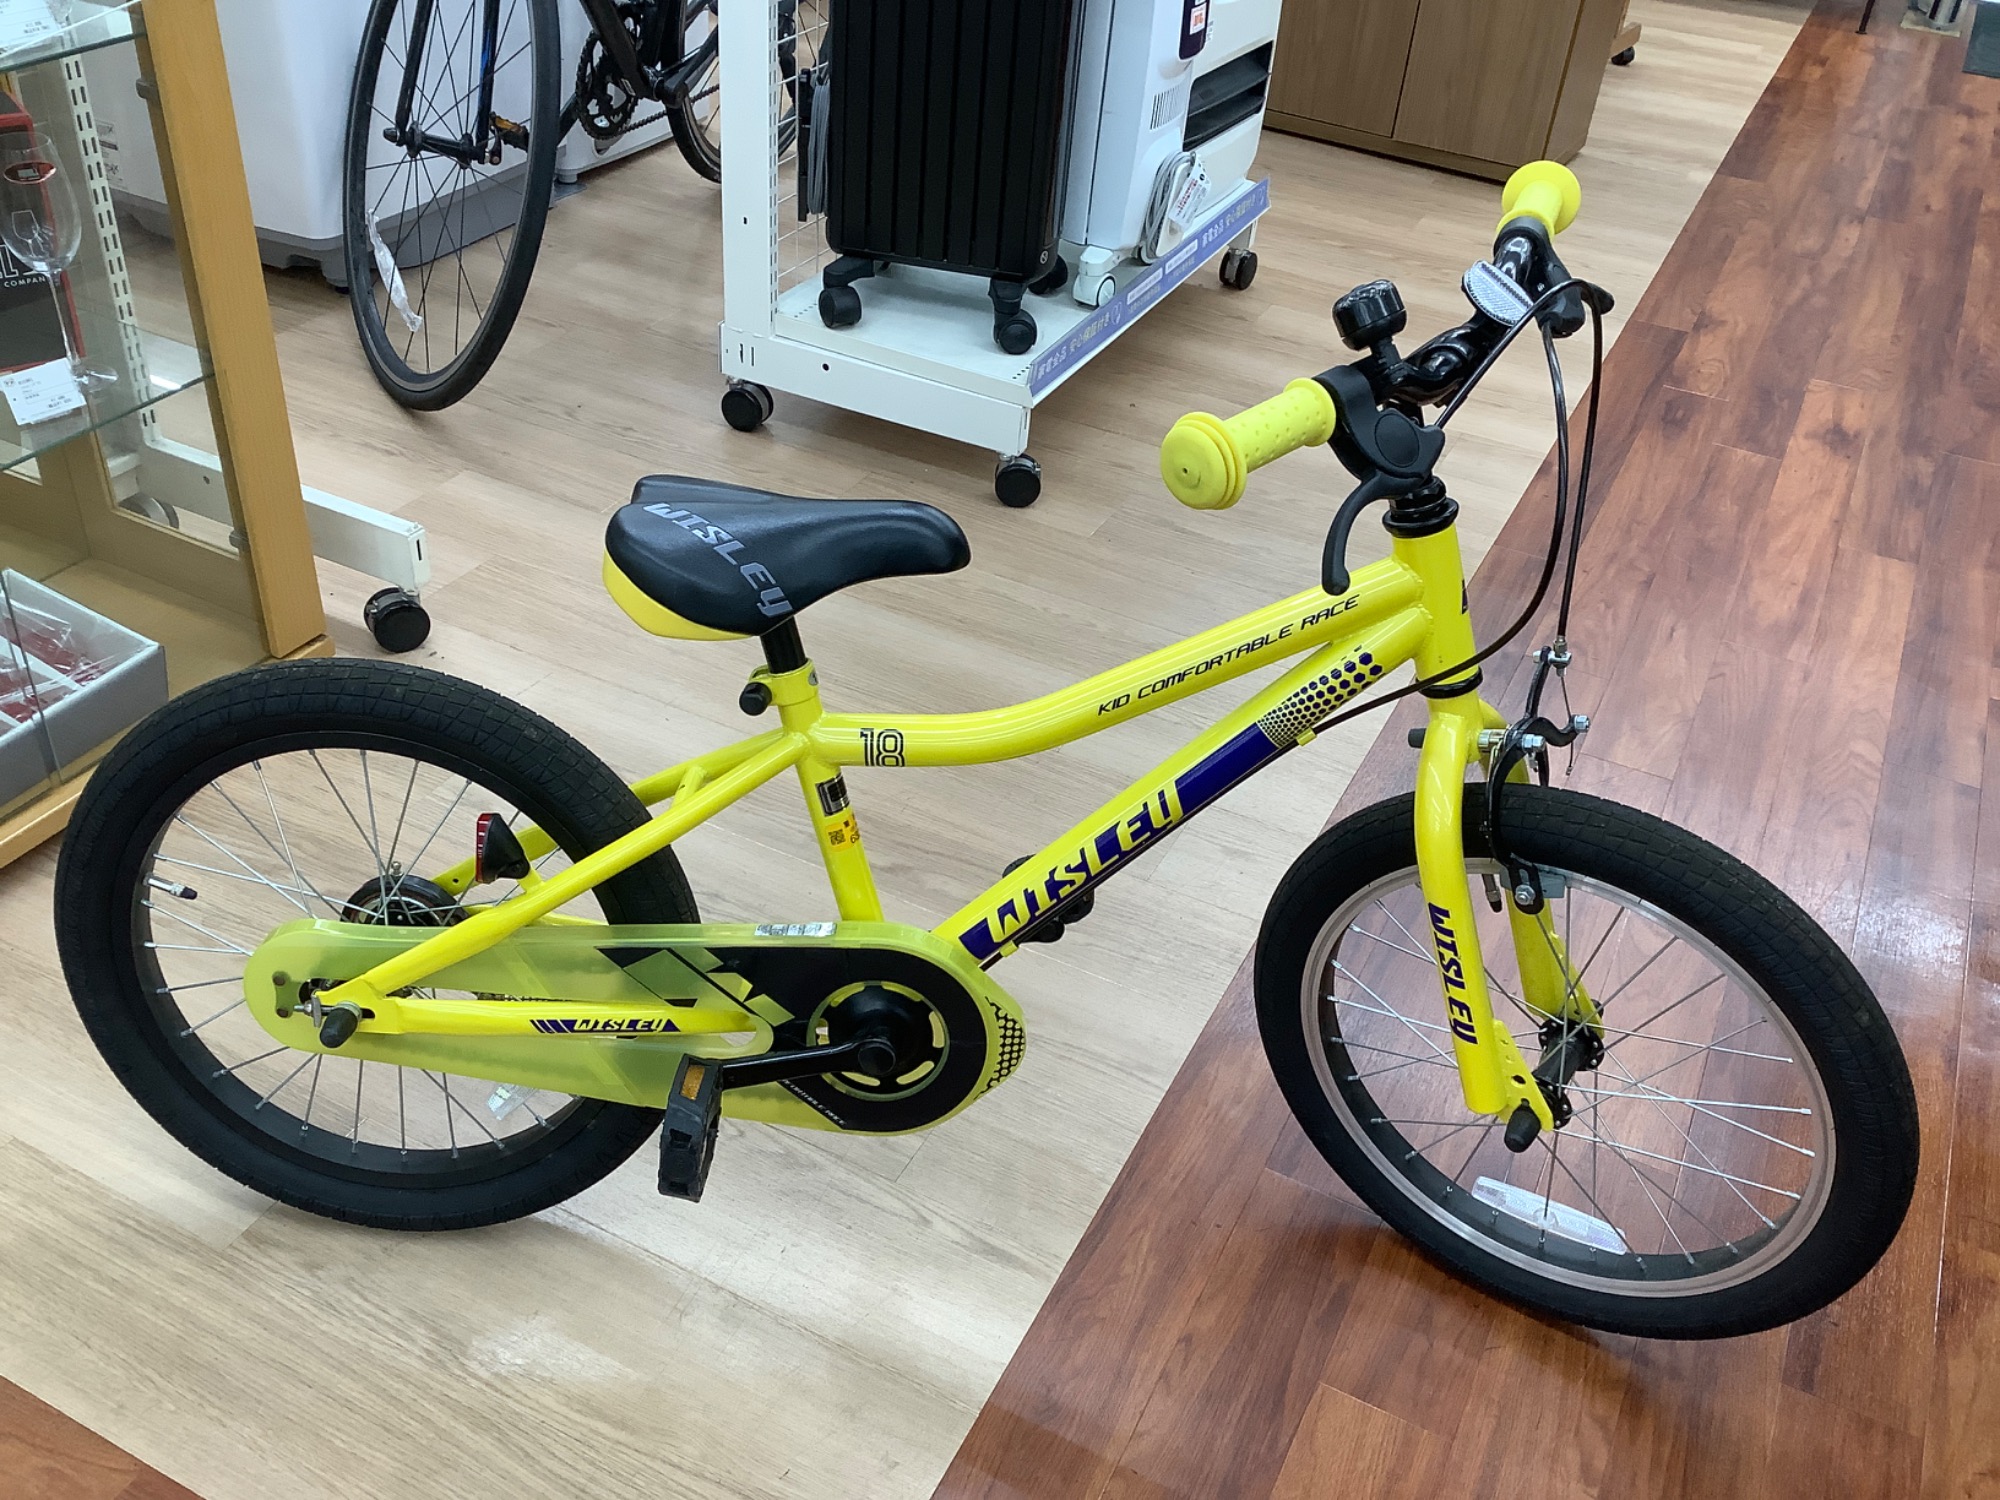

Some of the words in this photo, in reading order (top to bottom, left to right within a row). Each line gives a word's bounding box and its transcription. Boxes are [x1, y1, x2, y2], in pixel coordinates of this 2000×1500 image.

[4, 276, 47, 288] COMPAN
[643, 502, 793, 618] WISLEY
[1098, 693, 1131, 716] KID
[1137, 623, 1294, 699] COMFORTABLE
[1300, 593, 1360, 631] RACE
[860, 728, 905, 767] 18
[986, 779, 1184, 943] WISLEY
[573, 1018, 665, 1032] WISLEY
[1428, 902, 1479, 1045] WISLEY
